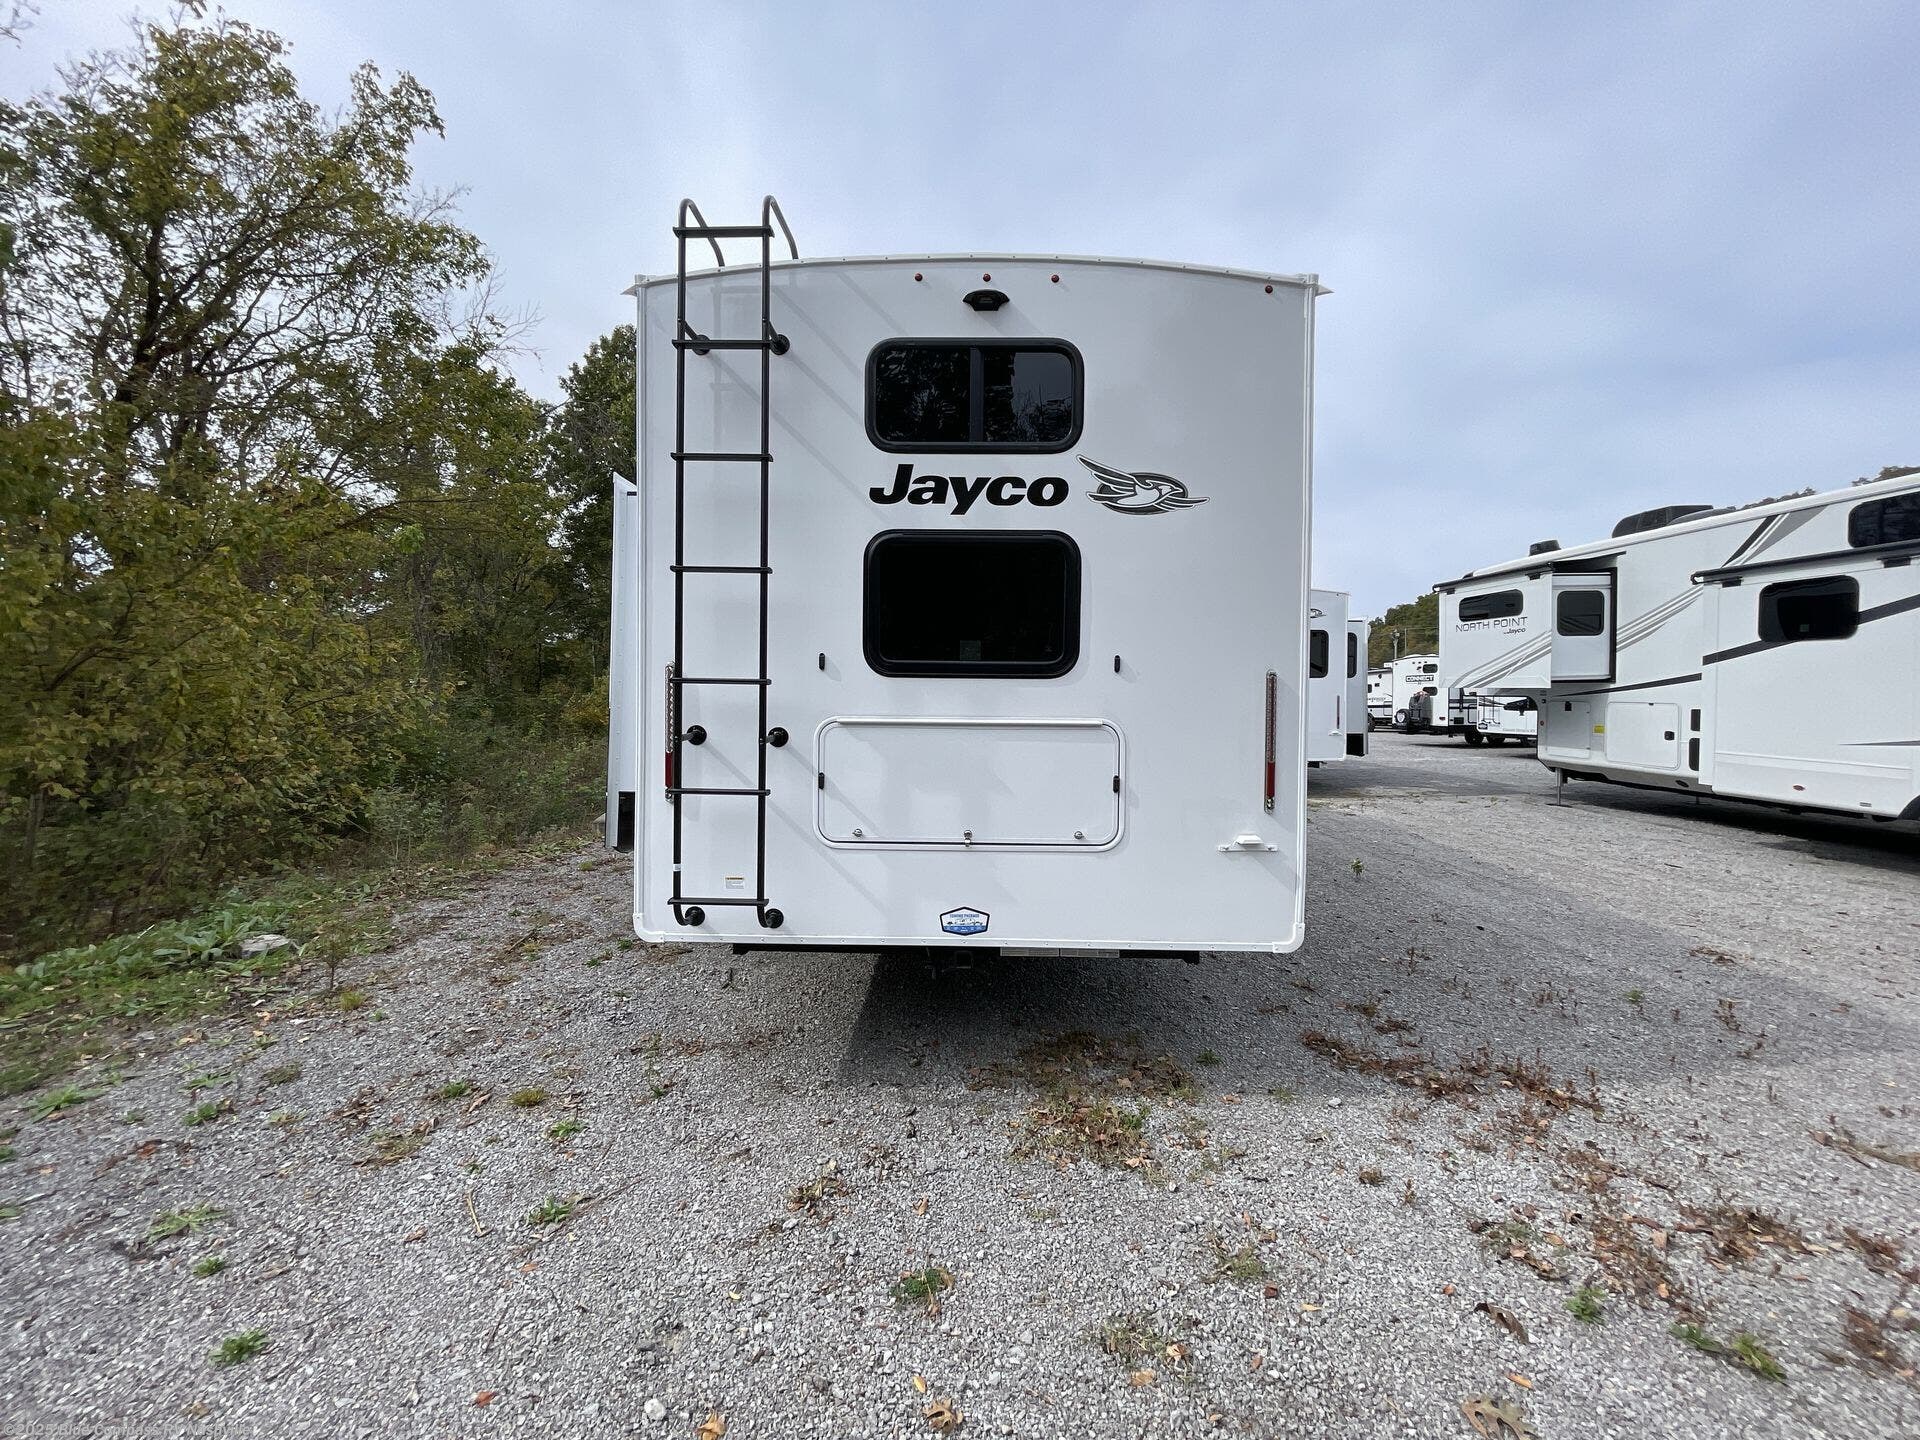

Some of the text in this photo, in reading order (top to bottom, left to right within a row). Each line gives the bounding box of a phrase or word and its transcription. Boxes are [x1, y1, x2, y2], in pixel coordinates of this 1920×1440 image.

[869, 464, 1069, 515] Jayco
[1456, 616, 1528, 632] NORTH POINT
[1507, 627, 1526, 635] Jayco
